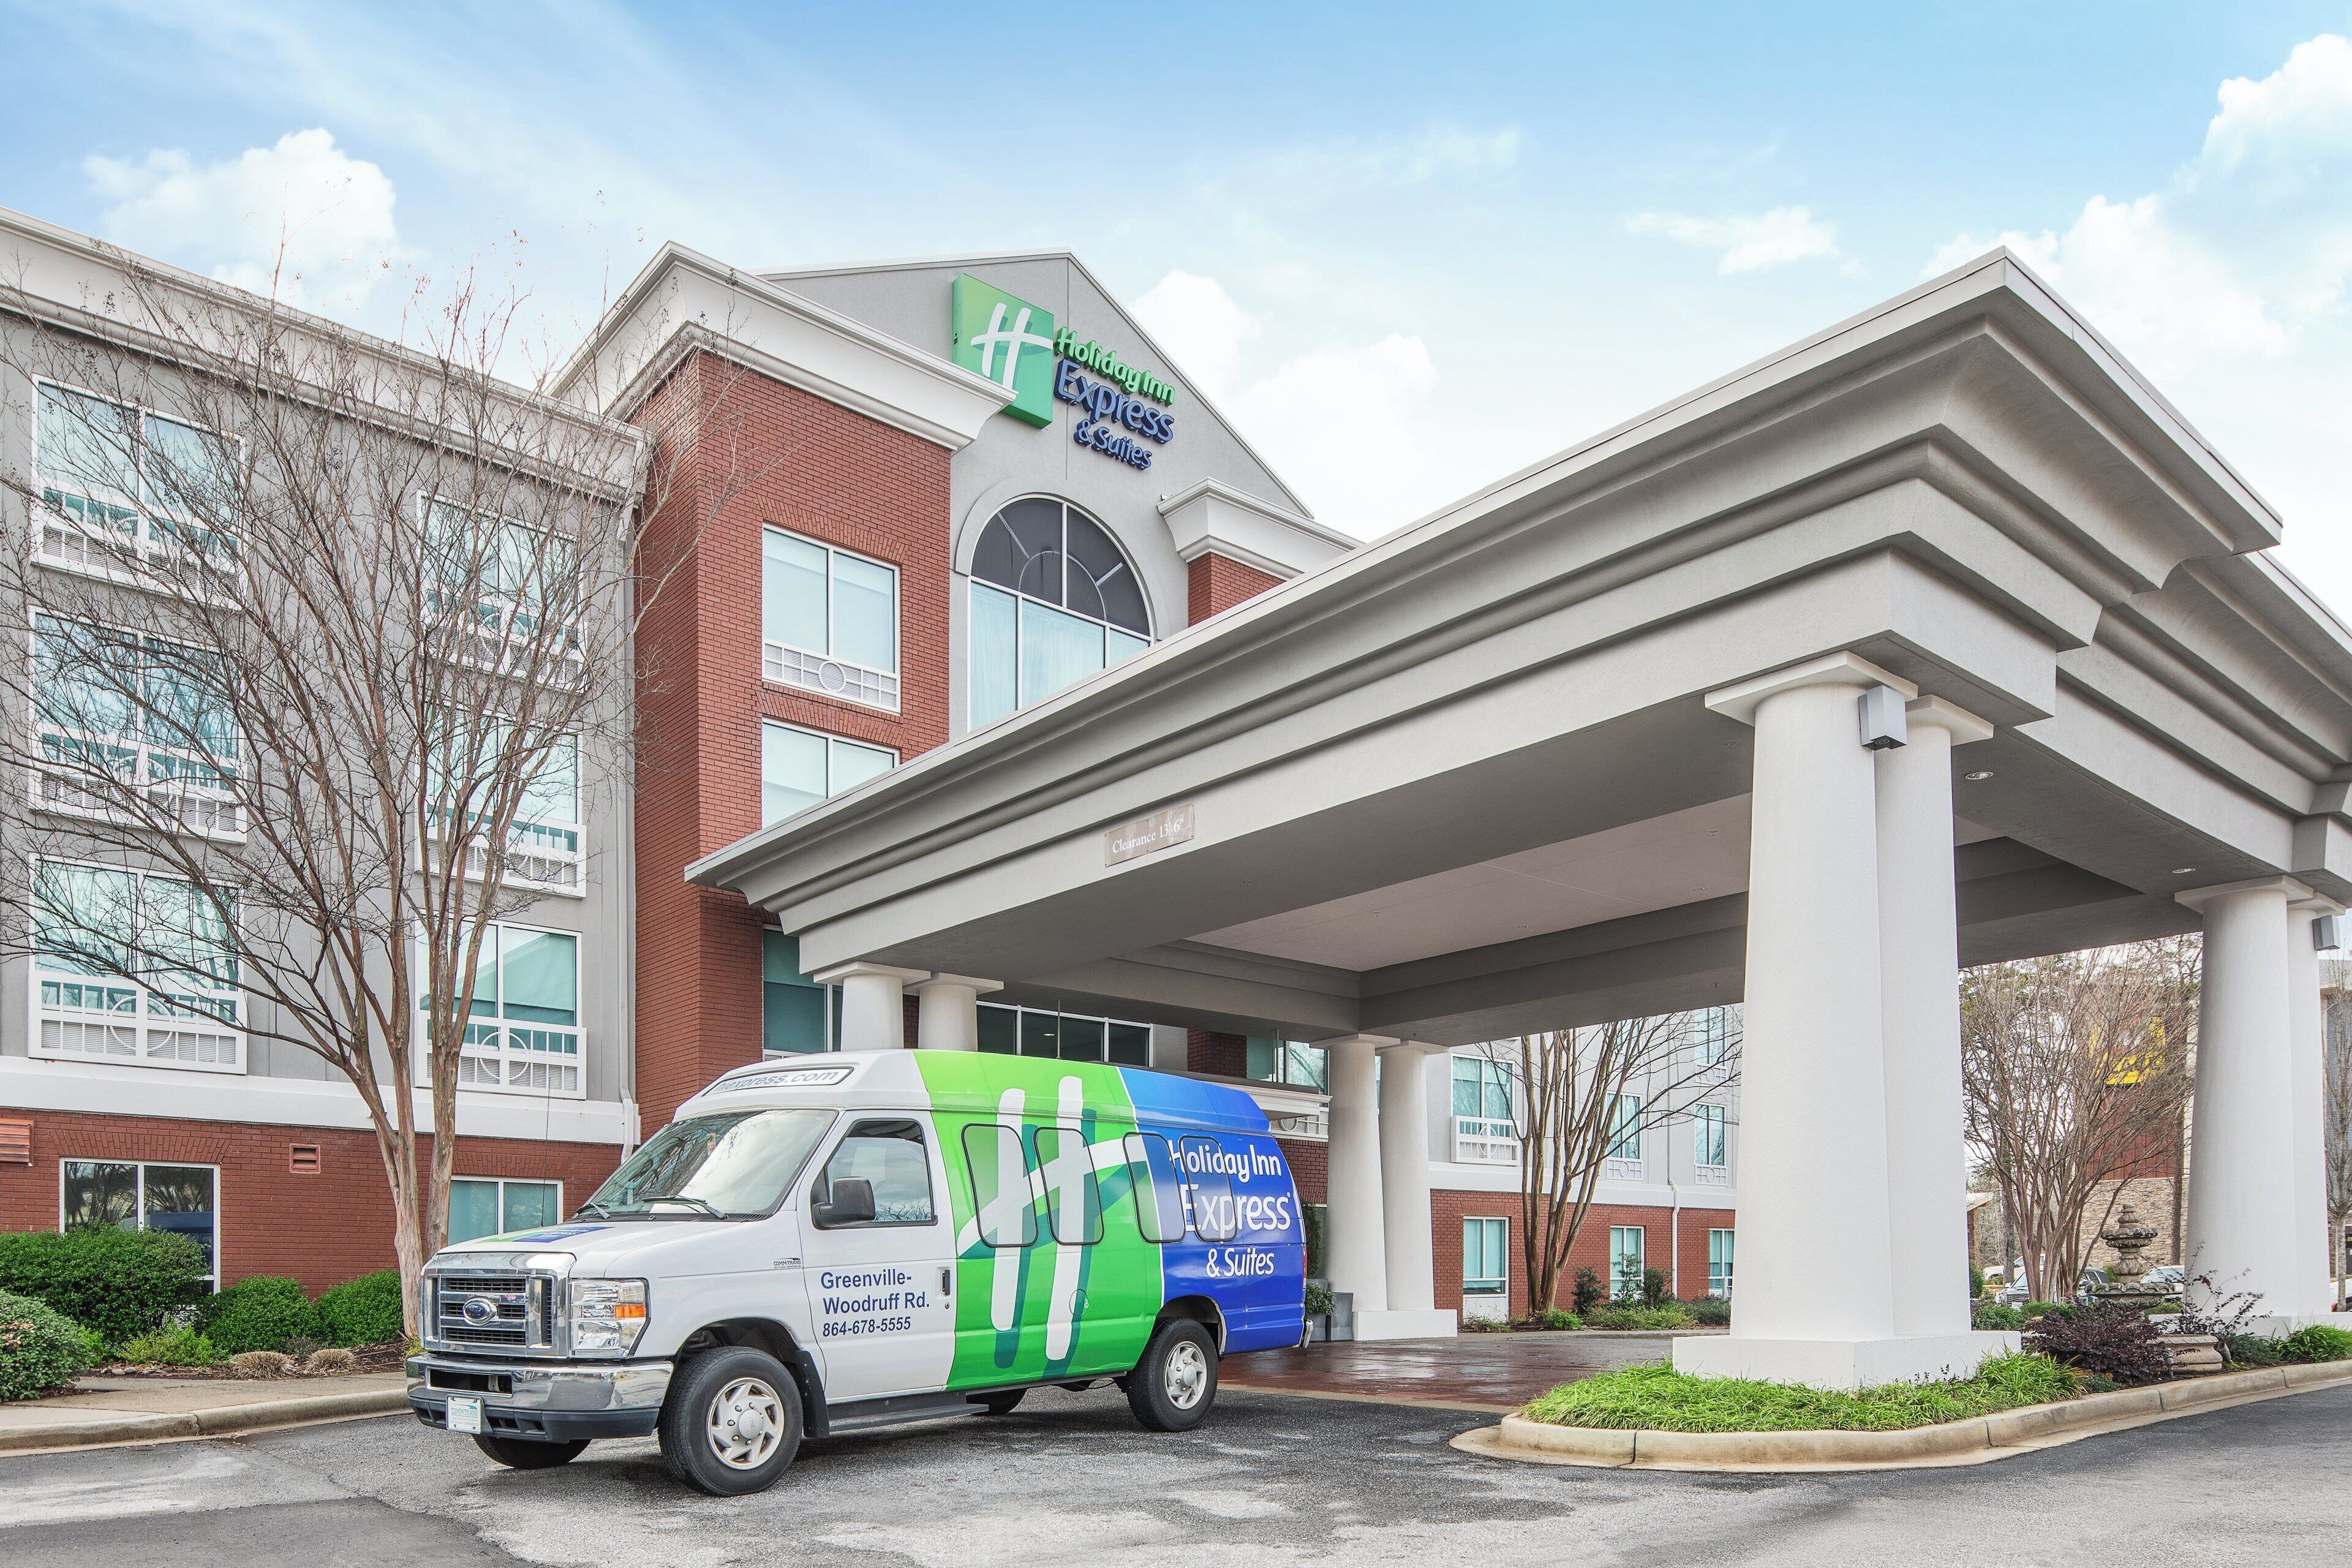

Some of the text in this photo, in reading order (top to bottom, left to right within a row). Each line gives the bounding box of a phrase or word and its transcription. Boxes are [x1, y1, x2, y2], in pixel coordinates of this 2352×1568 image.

[1054, 326, 1175, 407] Holiday Inn
[1054, 358, 1174, 445] Express
[1073, 418, 1152, 470] & Suites
[1112, 831, 1156, 854] Clearance
[1167, 1139, 1282, 1183] Holiday Inn
[1180, 1183, 1291, 1245] Express
[821, 1268, 912, 1289] Greenville-
[1206, 1247, 1275, 1278] & Suites
[823, 1291, 930, 1315] Woodruff Rd.
[823, 1316, 911, 1337] 864-678-5555
